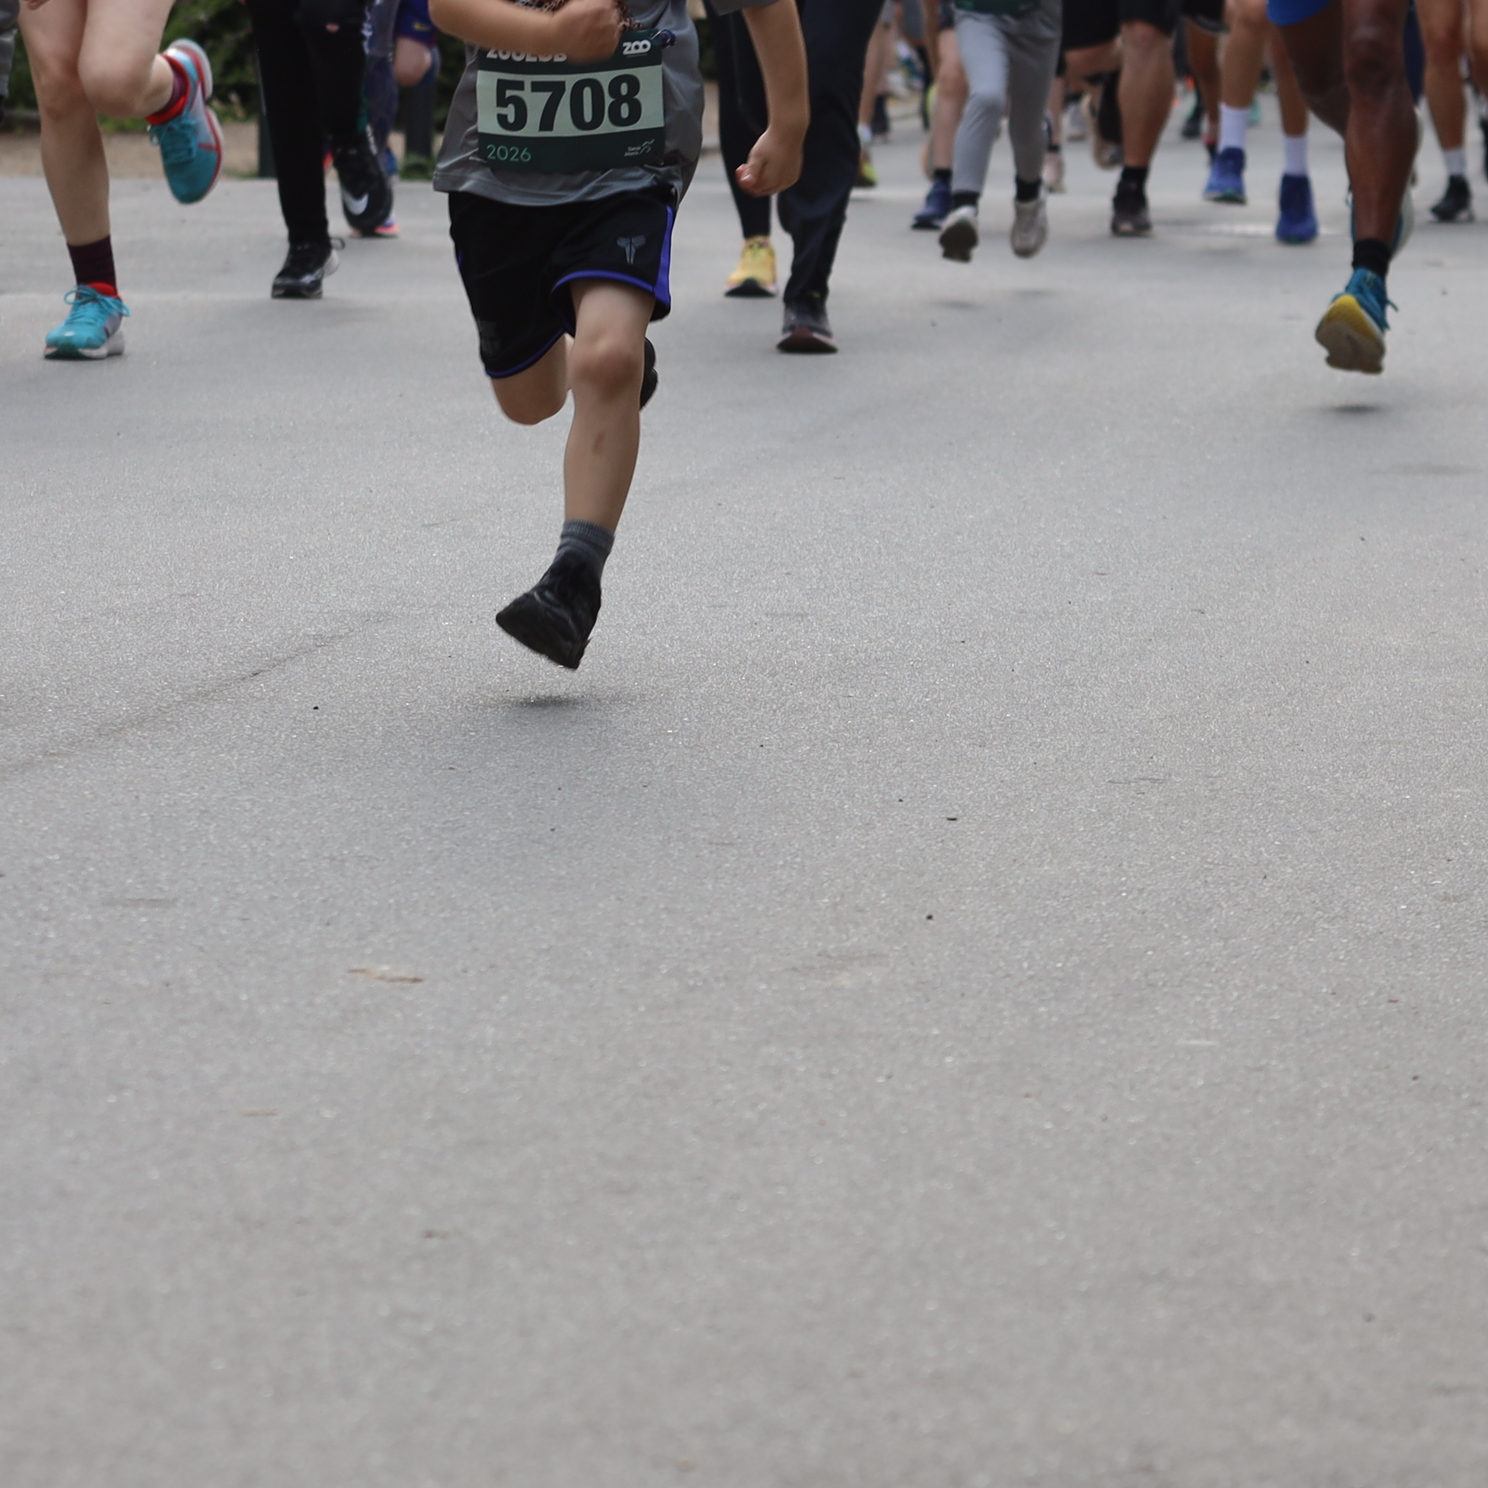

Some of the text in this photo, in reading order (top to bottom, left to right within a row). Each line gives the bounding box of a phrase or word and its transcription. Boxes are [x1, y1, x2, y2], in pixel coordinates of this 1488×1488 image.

[622, 40, 651, 55] ZOO
[496, 73, 642, 132] 5708
[486, 144, 531, 162] 2026
